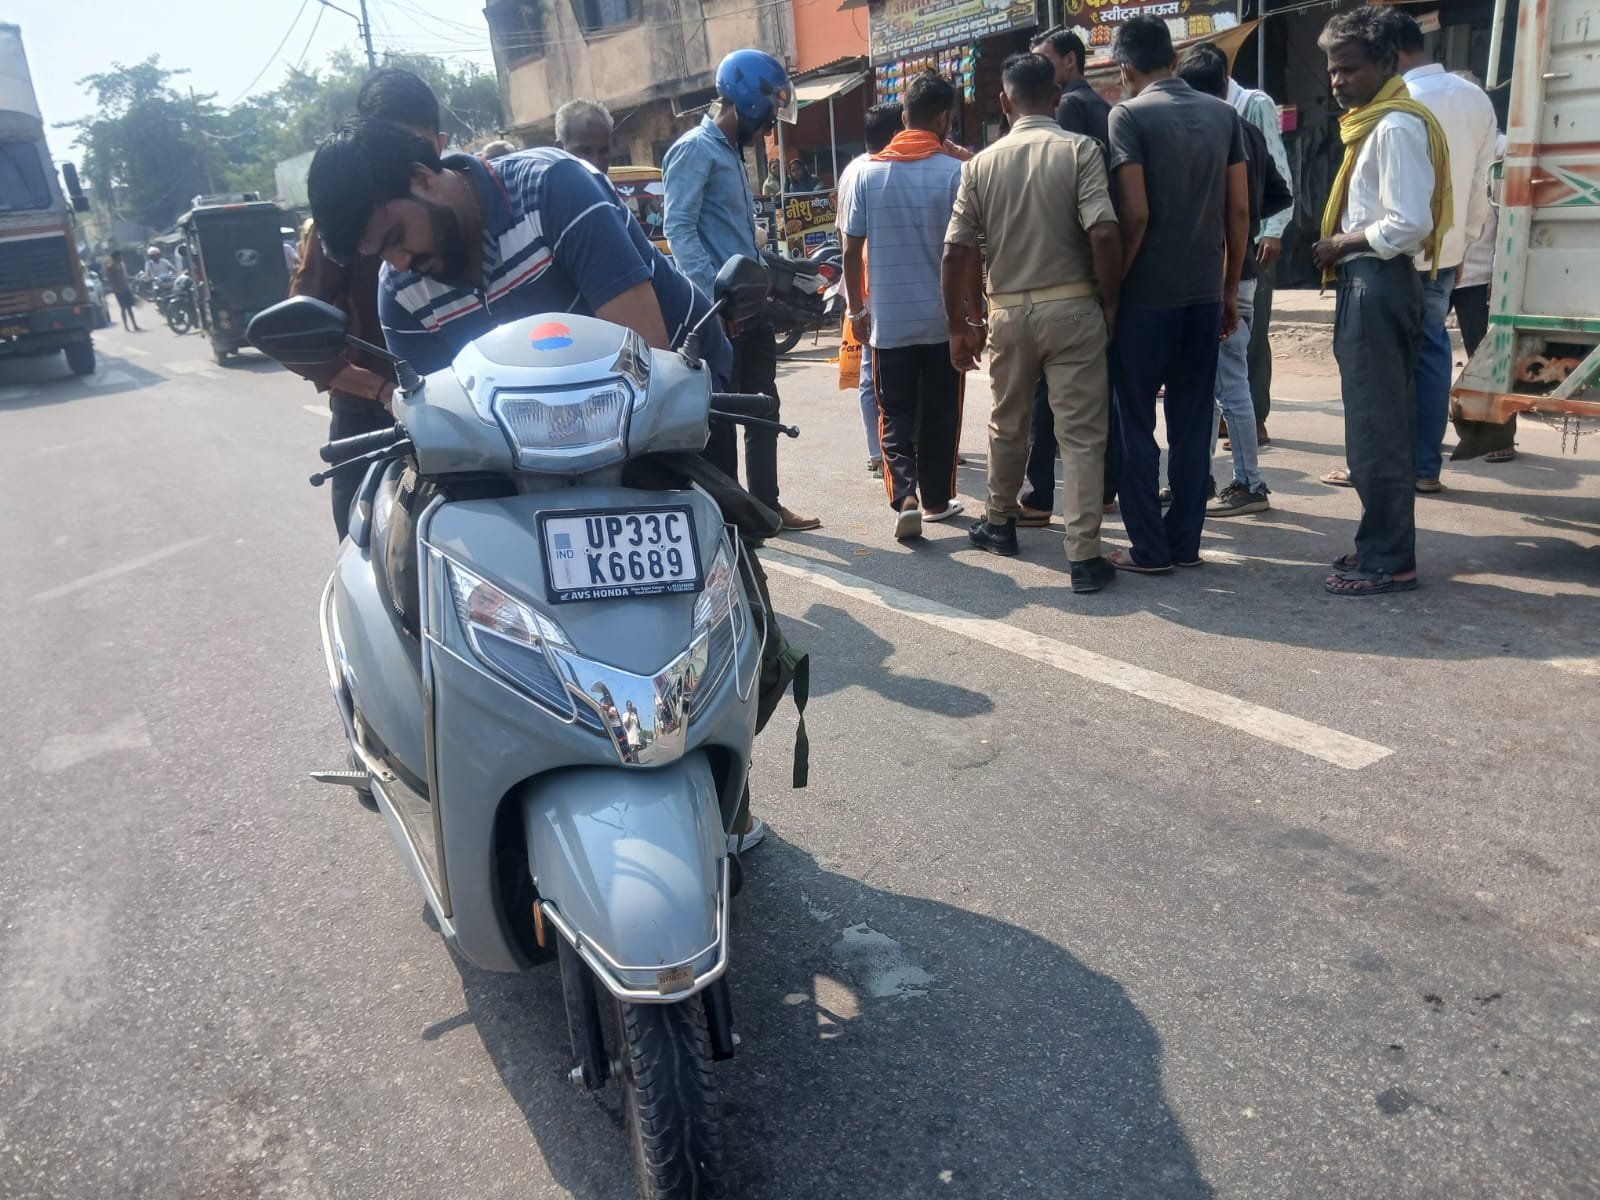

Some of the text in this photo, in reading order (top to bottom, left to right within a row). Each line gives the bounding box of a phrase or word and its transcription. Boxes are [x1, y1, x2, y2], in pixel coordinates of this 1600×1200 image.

[785, 198, 813, 221] नीशु
[585, 514, 682, 549] UP33C
[557, 549, 574, 559] IND
[587, 547, 683, 584] K6689
[571, 590, 592, 600] AVS
[592, 588, 629, 599] HONDA
